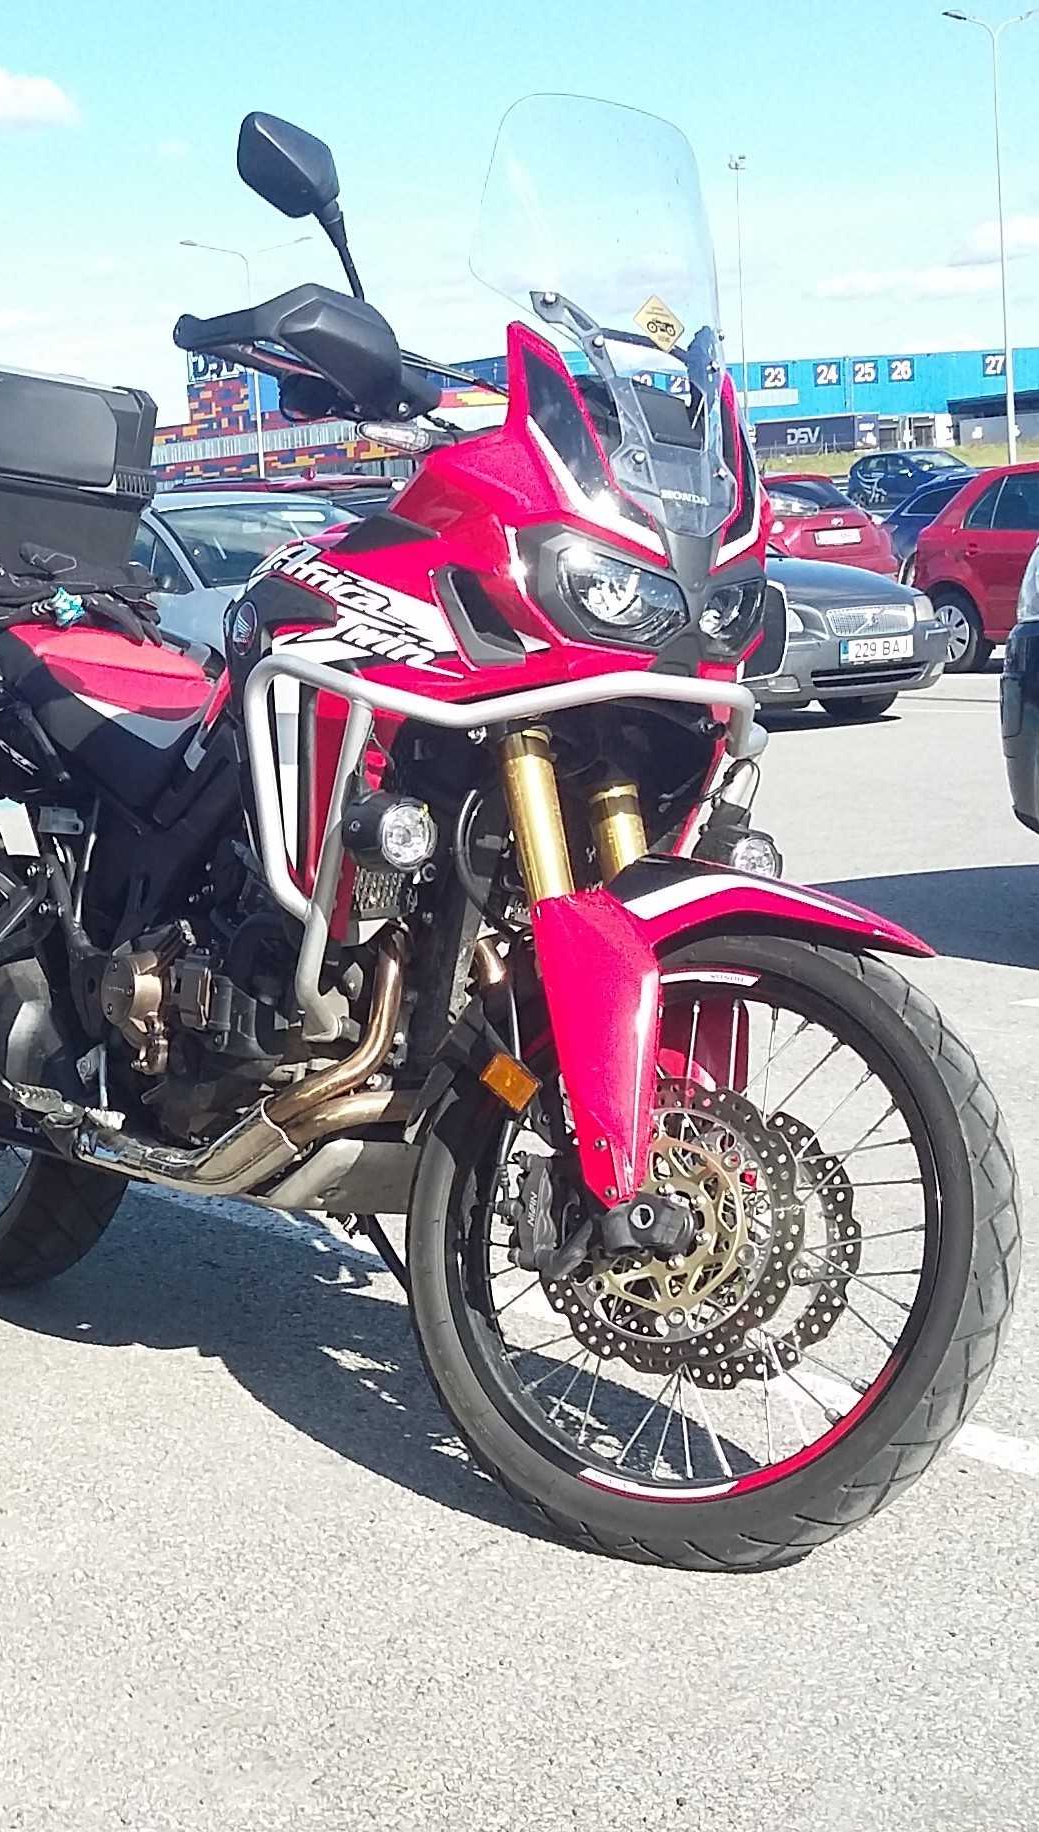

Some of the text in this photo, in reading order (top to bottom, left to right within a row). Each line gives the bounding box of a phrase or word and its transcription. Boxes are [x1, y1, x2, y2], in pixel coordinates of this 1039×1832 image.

[816, 364, 838, 384] 24
[854, 362, 876, 383] 25
[985, 356, 1005, 375] 27
[764, 367, 786, 388] 23
[786, 426, 820, 445] DSV
[660, 489, 710, 506] HONDA
[281, 614, 469, 680] Twin
[855, 642, 877, 658] 229
